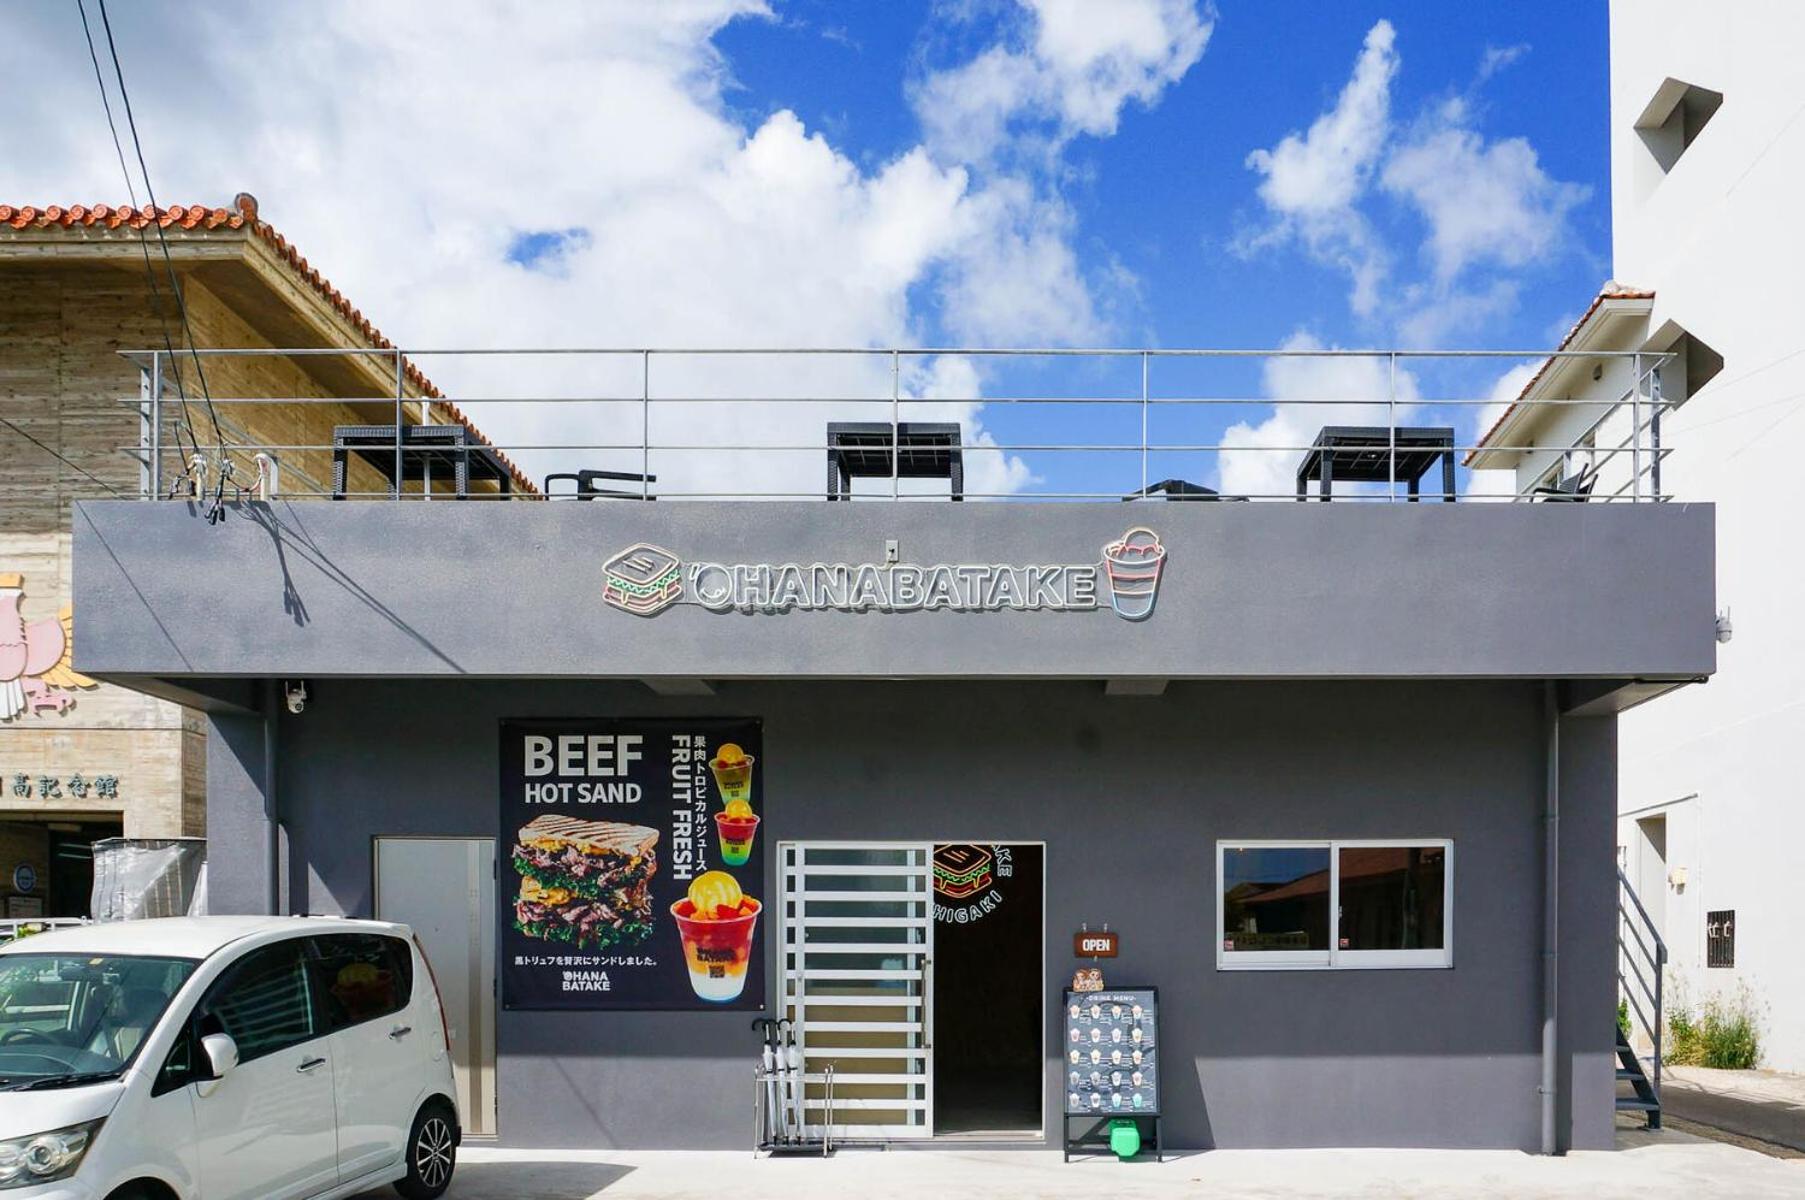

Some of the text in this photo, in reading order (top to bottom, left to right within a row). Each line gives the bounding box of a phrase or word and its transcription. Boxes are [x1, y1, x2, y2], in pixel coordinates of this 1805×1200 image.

[524, 735, 643, 777] BEEF
[0, 773, 120, 799] 高記念館
[525, 783, 642, 804] HOT SAND
[672, 735, 693, 880] FRUIT FRESH
[1082, 938, 1111, 952] OPEN
[562, 981, 611, 992] BATAKE
